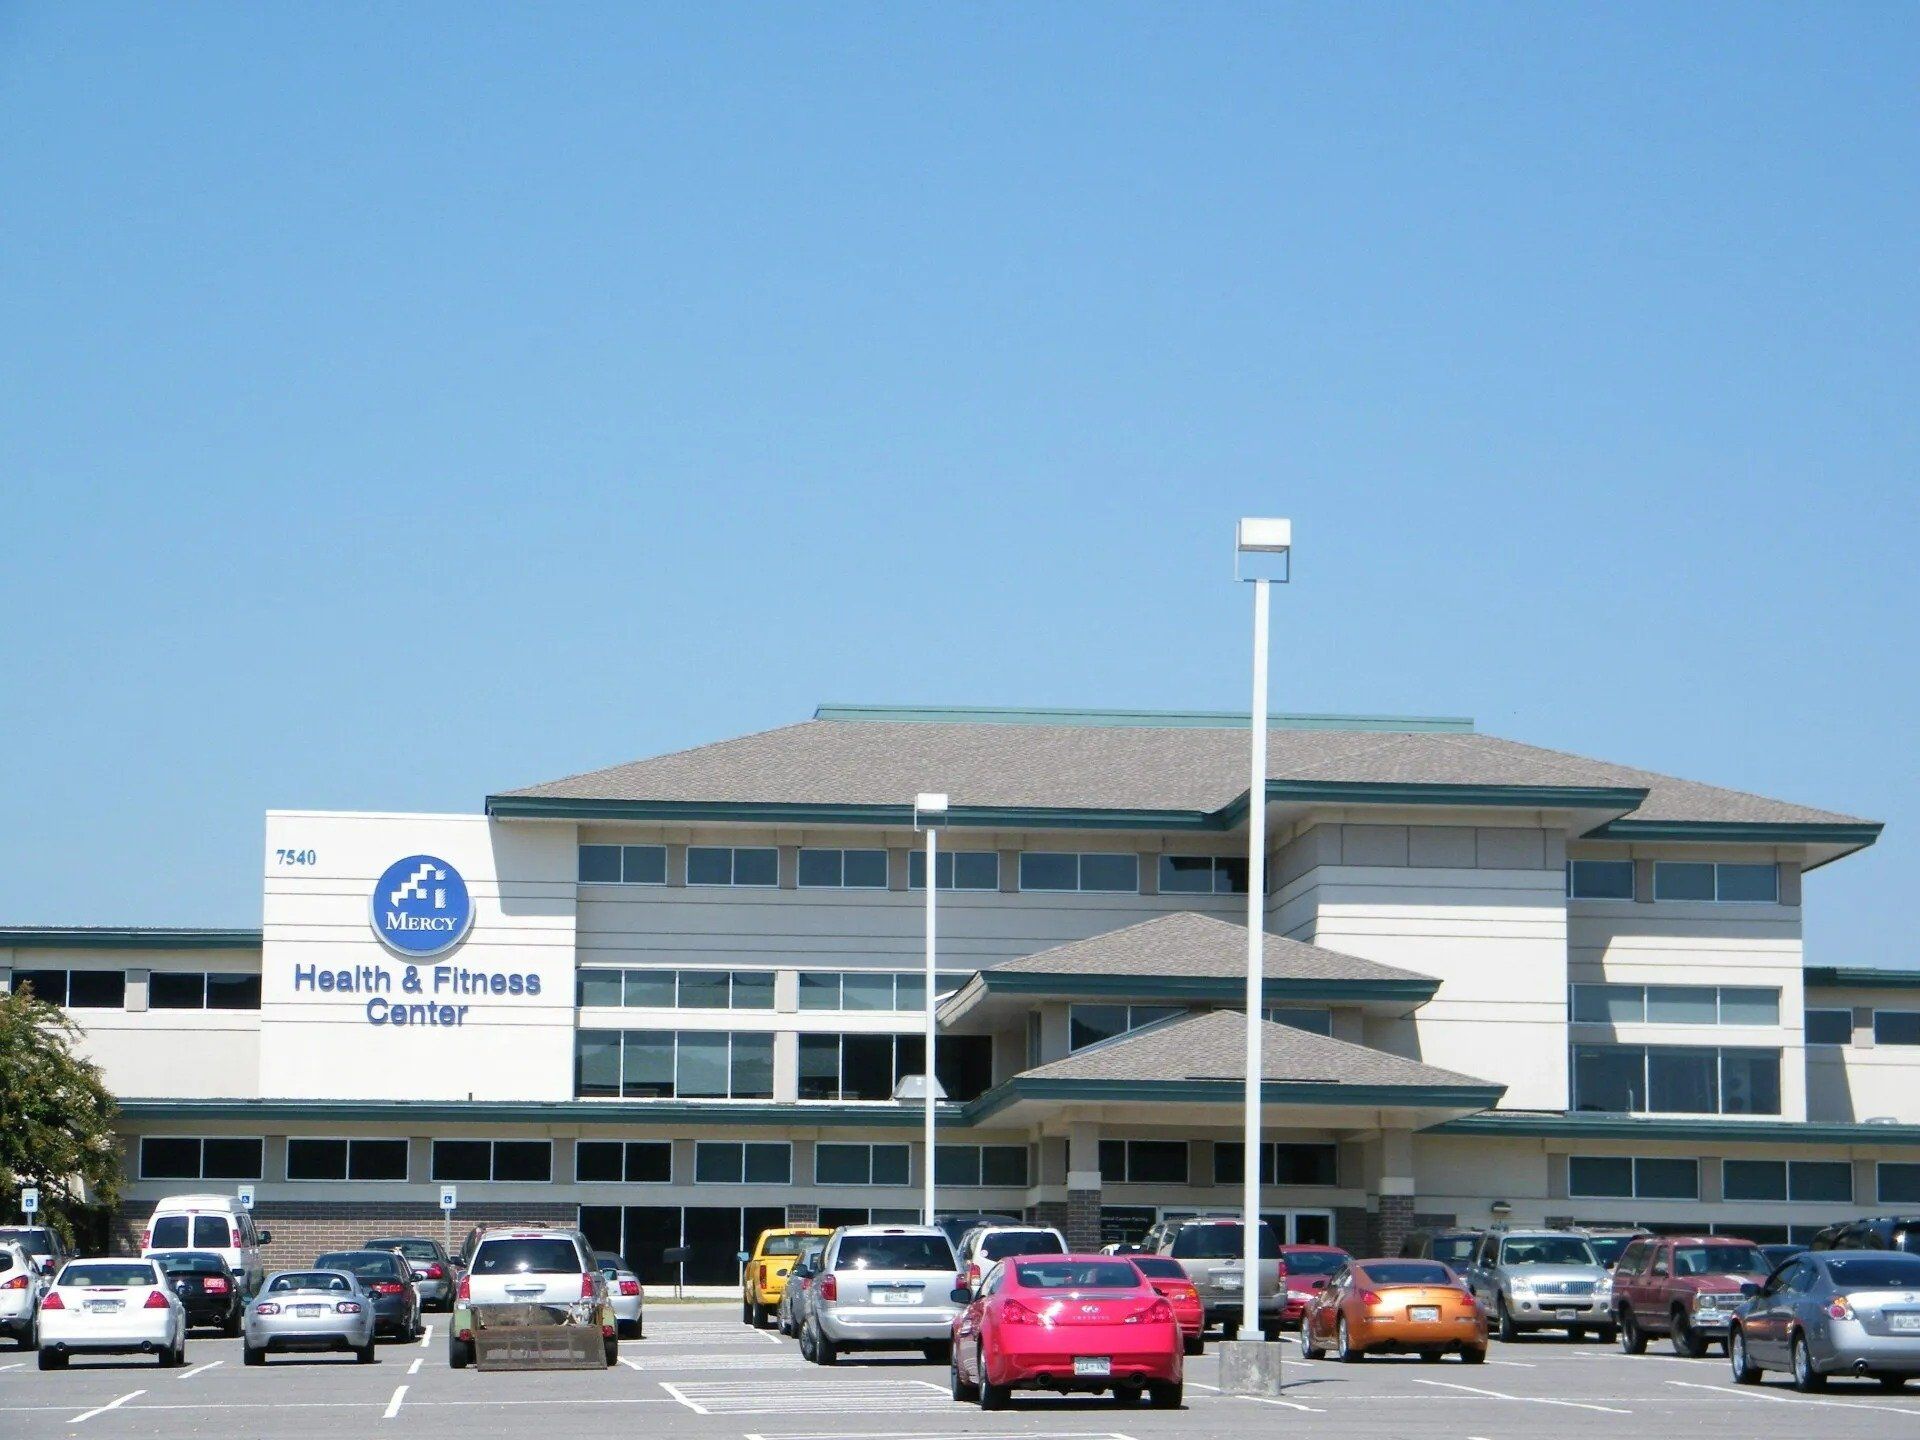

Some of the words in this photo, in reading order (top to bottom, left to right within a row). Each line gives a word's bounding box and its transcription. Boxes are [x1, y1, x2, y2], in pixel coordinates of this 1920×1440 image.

[276, 850, 316, 865] 7540
[386, 911, 458, 931] MERCY
[295, 963, 391, 993] Health
[402, 965, 423, 994] &
[434, 966, 541, 995] Fitness
[366, 997, 469, 1027] Center
